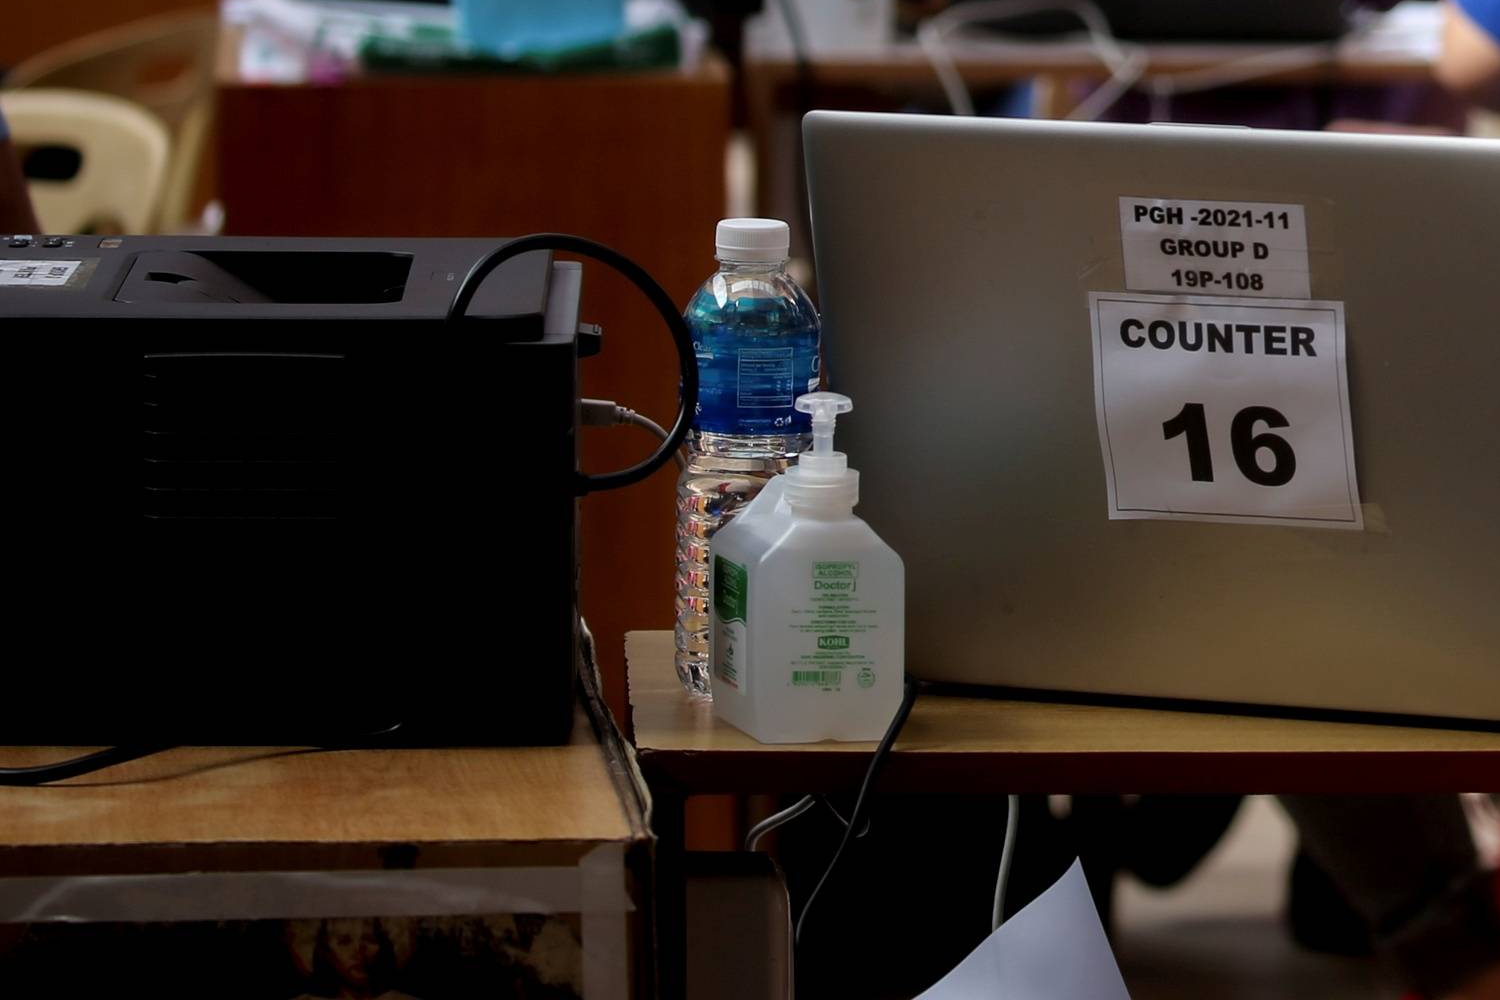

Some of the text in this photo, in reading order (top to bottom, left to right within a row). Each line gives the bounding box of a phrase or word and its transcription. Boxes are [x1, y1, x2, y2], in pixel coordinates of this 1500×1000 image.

[1133, 204, 1290, 230] PGH -2021-11
[1159, 238, 1269, 260] GROUP D
[1171, 269, 1264, 291] 19P-108
[1119, 318, 1317, 357] COUNTER
[1162, 402, 1296, 487] 16
[814, 581, 851, 590] Doctor
[819, 637, 848, 647] KOHL
